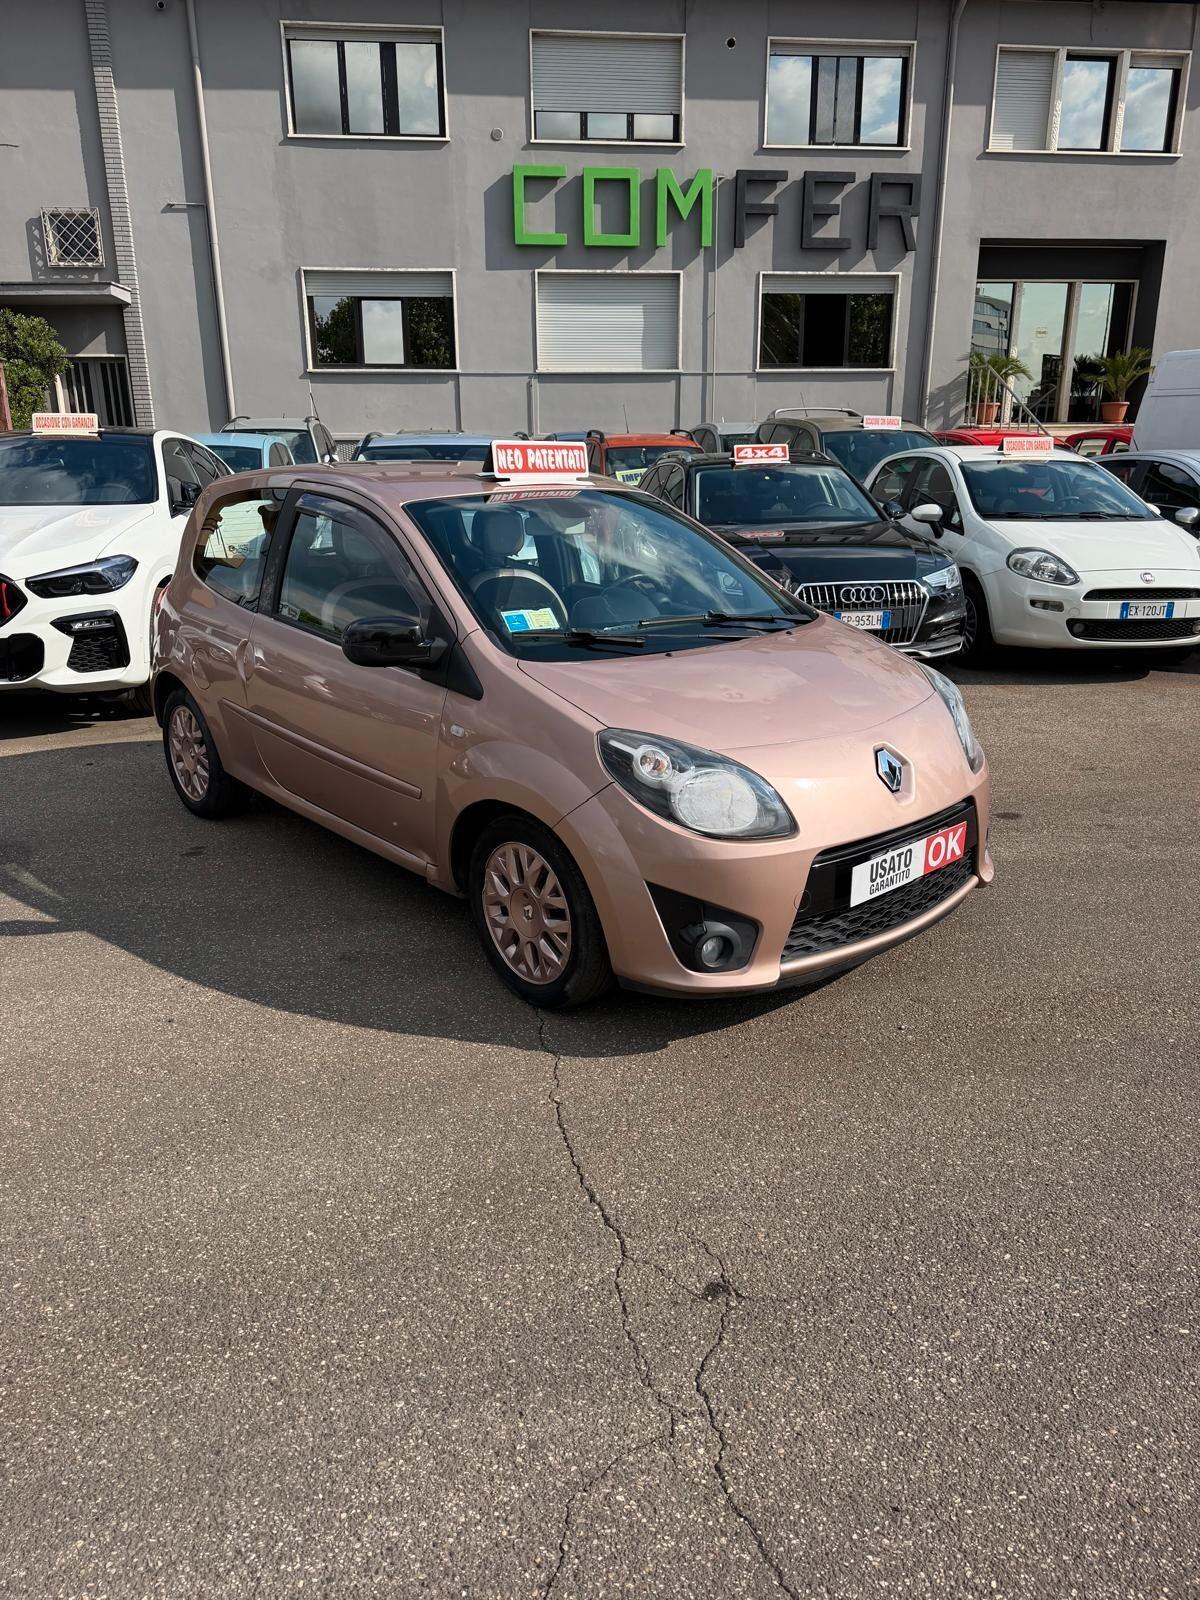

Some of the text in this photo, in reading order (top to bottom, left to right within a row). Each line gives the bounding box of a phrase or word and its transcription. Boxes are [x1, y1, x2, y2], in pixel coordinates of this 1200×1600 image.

[512, 164, 922, 251] COMFER
[497, 447, 585, 470] NEO PATENTATI
[928, 827, 964, 867] OK
[869, 868, 910, 895] GARANTITO
[870, 848, 912, 883] USATO
